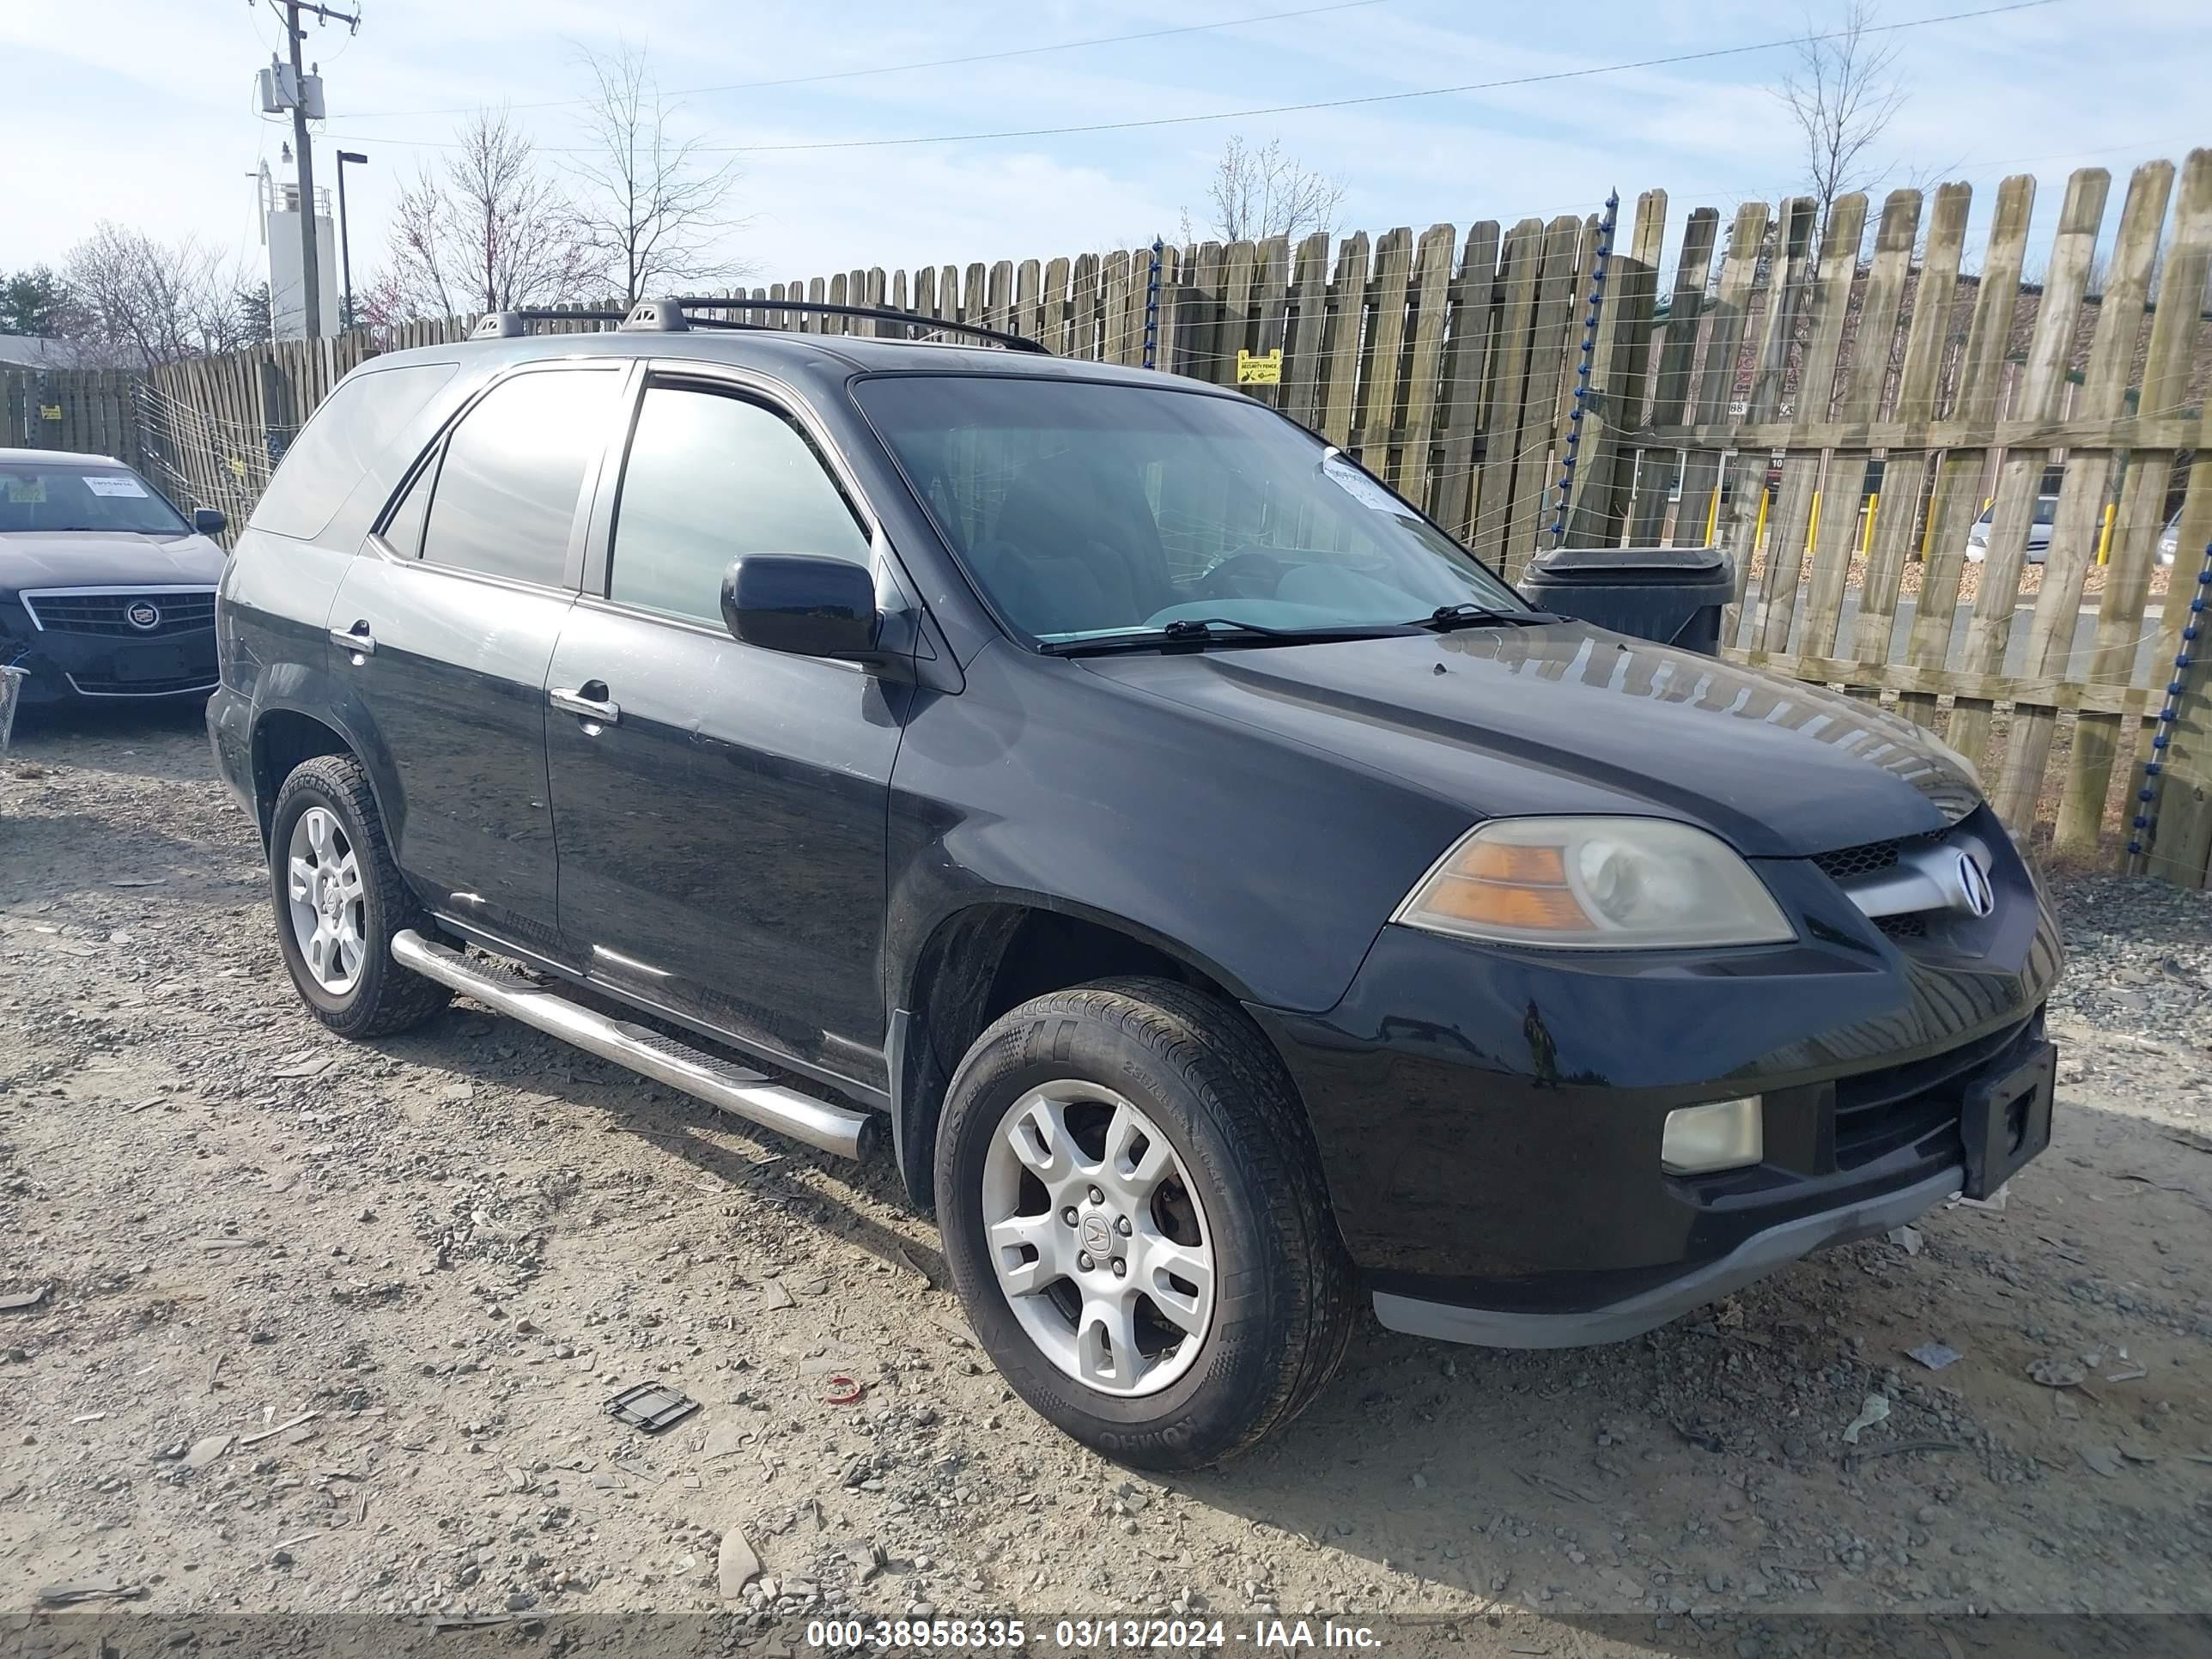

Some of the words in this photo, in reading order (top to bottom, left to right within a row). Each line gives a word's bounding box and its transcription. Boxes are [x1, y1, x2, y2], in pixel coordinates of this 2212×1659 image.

[940, 1110, 963, 1229] SOLUS
[962, 1080, 981, 1109] TA31
[1098, 1415, 1197, 1454] KUMHO
